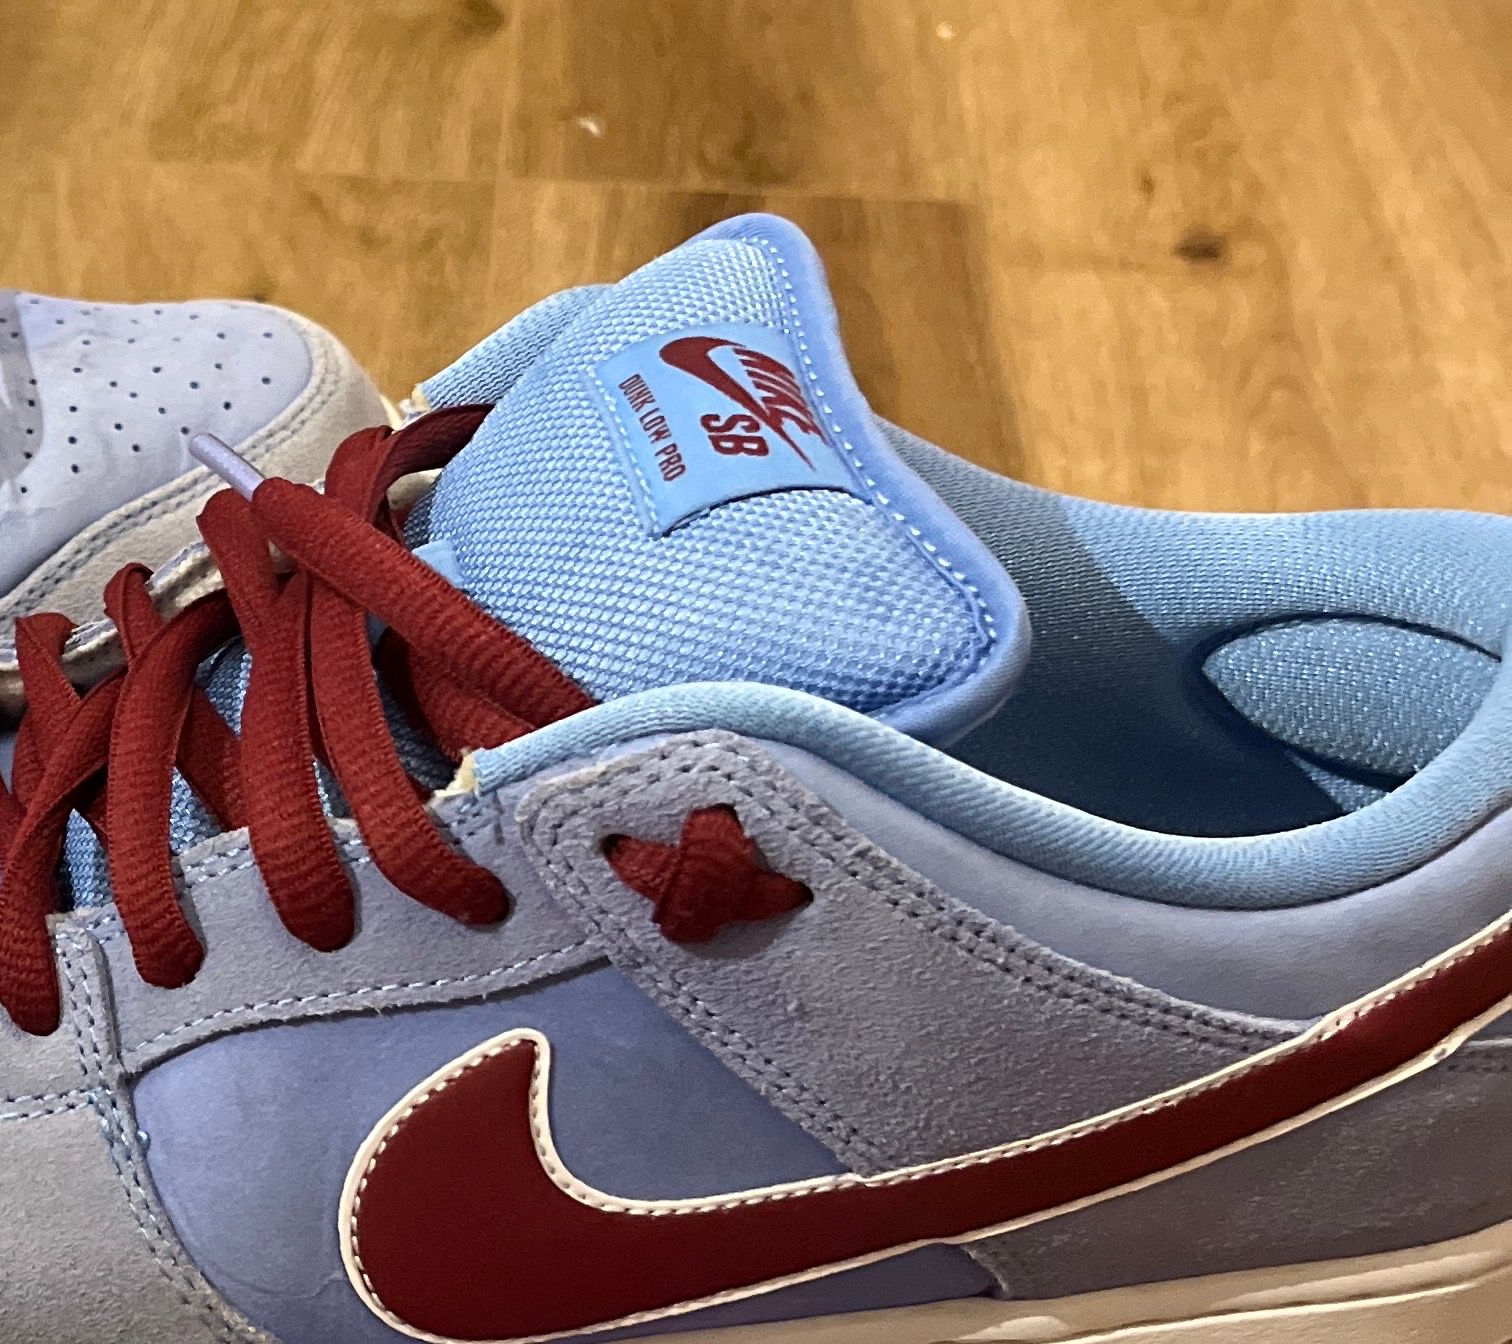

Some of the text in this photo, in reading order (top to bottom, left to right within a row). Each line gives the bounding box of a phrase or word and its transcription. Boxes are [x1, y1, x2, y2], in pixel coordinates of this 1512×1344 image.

[618, 373, 686, 482] DUNK LOW PRO
[700, 413, 770, 456] SB
[733, 347, 832, 446] NIKE
